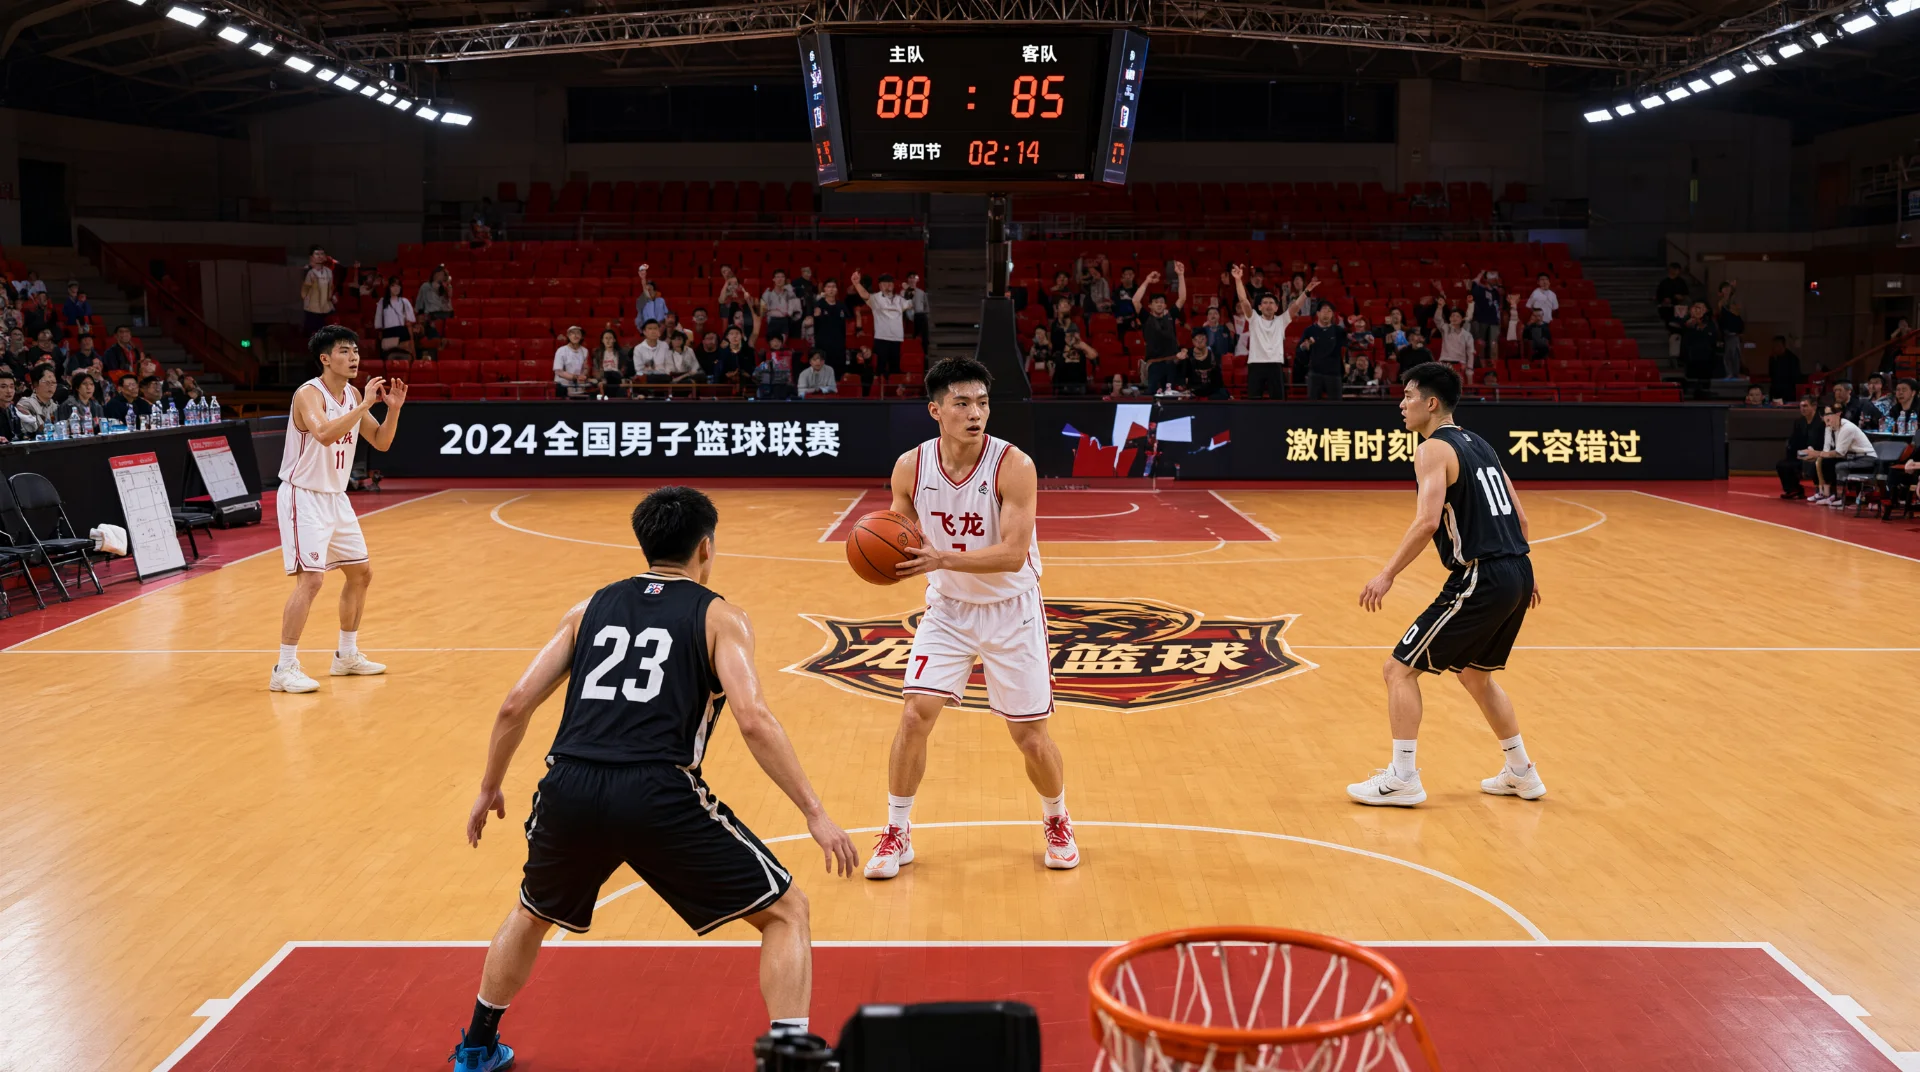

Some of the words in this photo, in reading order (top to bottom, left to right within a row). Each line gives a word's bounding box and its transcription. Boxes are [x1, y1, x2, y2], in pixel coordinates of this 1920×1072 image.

[889, 45, 925, 63] 主队
[1021, 44, 1058, 63] 客队
[876, 75, 931, 118] 88
[1010, 75, 1065, 118] 85
[892, 142, 942, 161] 第四节
[968, 140, 1040, 166] 02:14
[1286, 428, 1418, 462] 激情时刻
[1509, 429, 1642, 463] 不容错过
[335, 450, 345, 470] 11
[1475, 466, 1513, 517] 10
[931, 511, 985, 537] 飞龙
[580, 624, 674, 703] 23
[914, 655, 929, 680] 7
